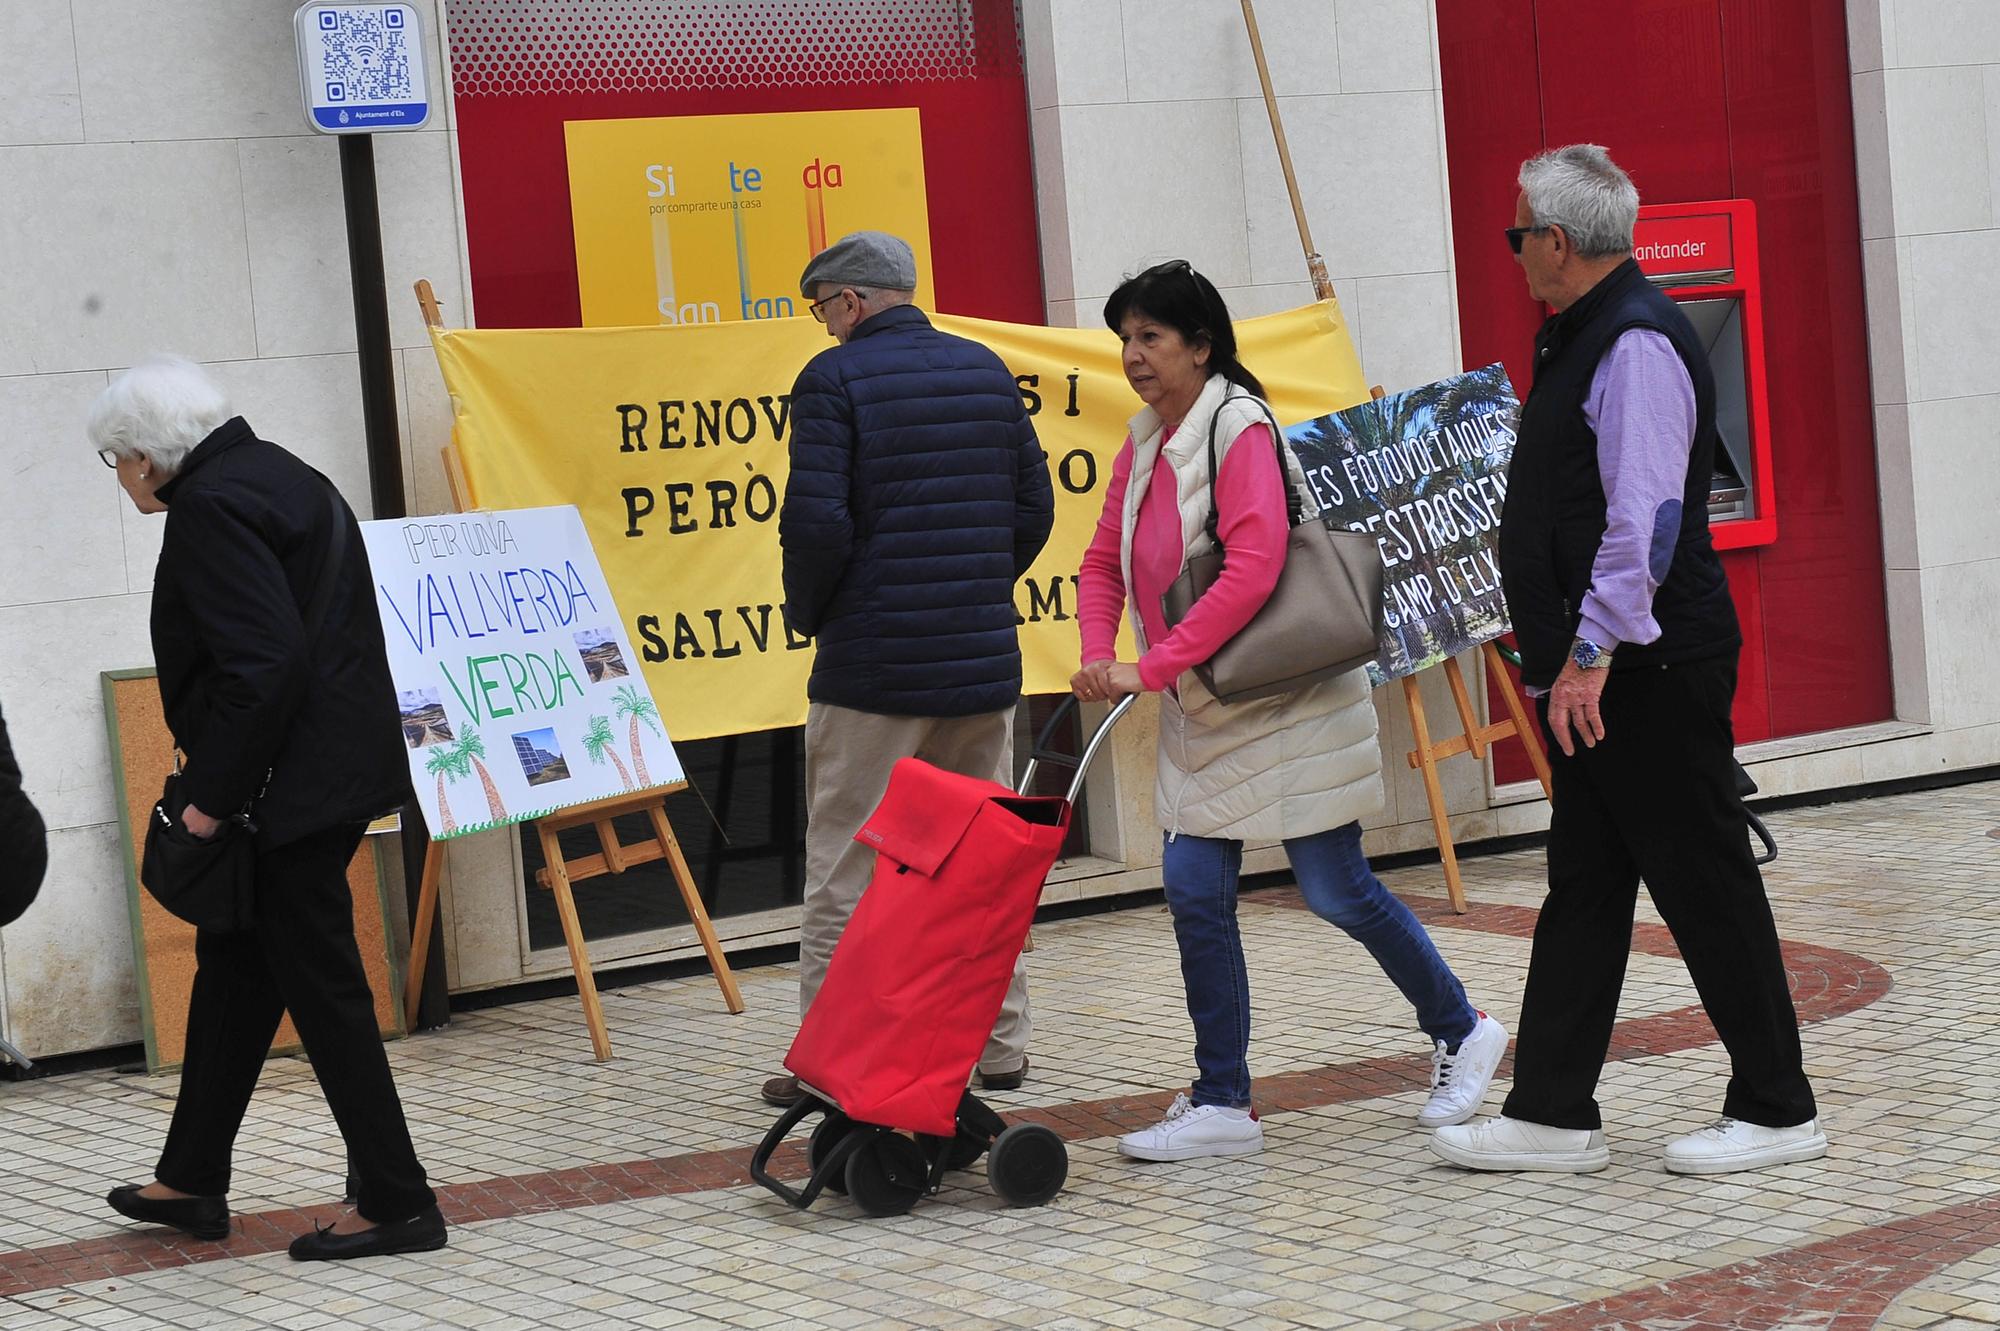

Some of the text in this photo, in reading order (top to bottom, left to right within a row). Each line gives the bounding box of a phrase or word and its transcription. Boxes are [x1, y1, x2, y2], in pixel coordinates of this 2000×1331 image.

[645, 158, 843, 198] Si te da
[649, 199, 762, 215] por comprarte una casa
[1632, 239, 1706, 261] antander
[616, 394, 793, 453] RENOV
[621, 462, 776, 537] PERÒ
[1305, 464, 1344, 512] ES
[402, 520, 519, 564] PER UNA
[380, 560, 598, 655] VALLVERDA
[637, 603, 817, 663] SALVE
[439, 648, 585, 728] VERDA
